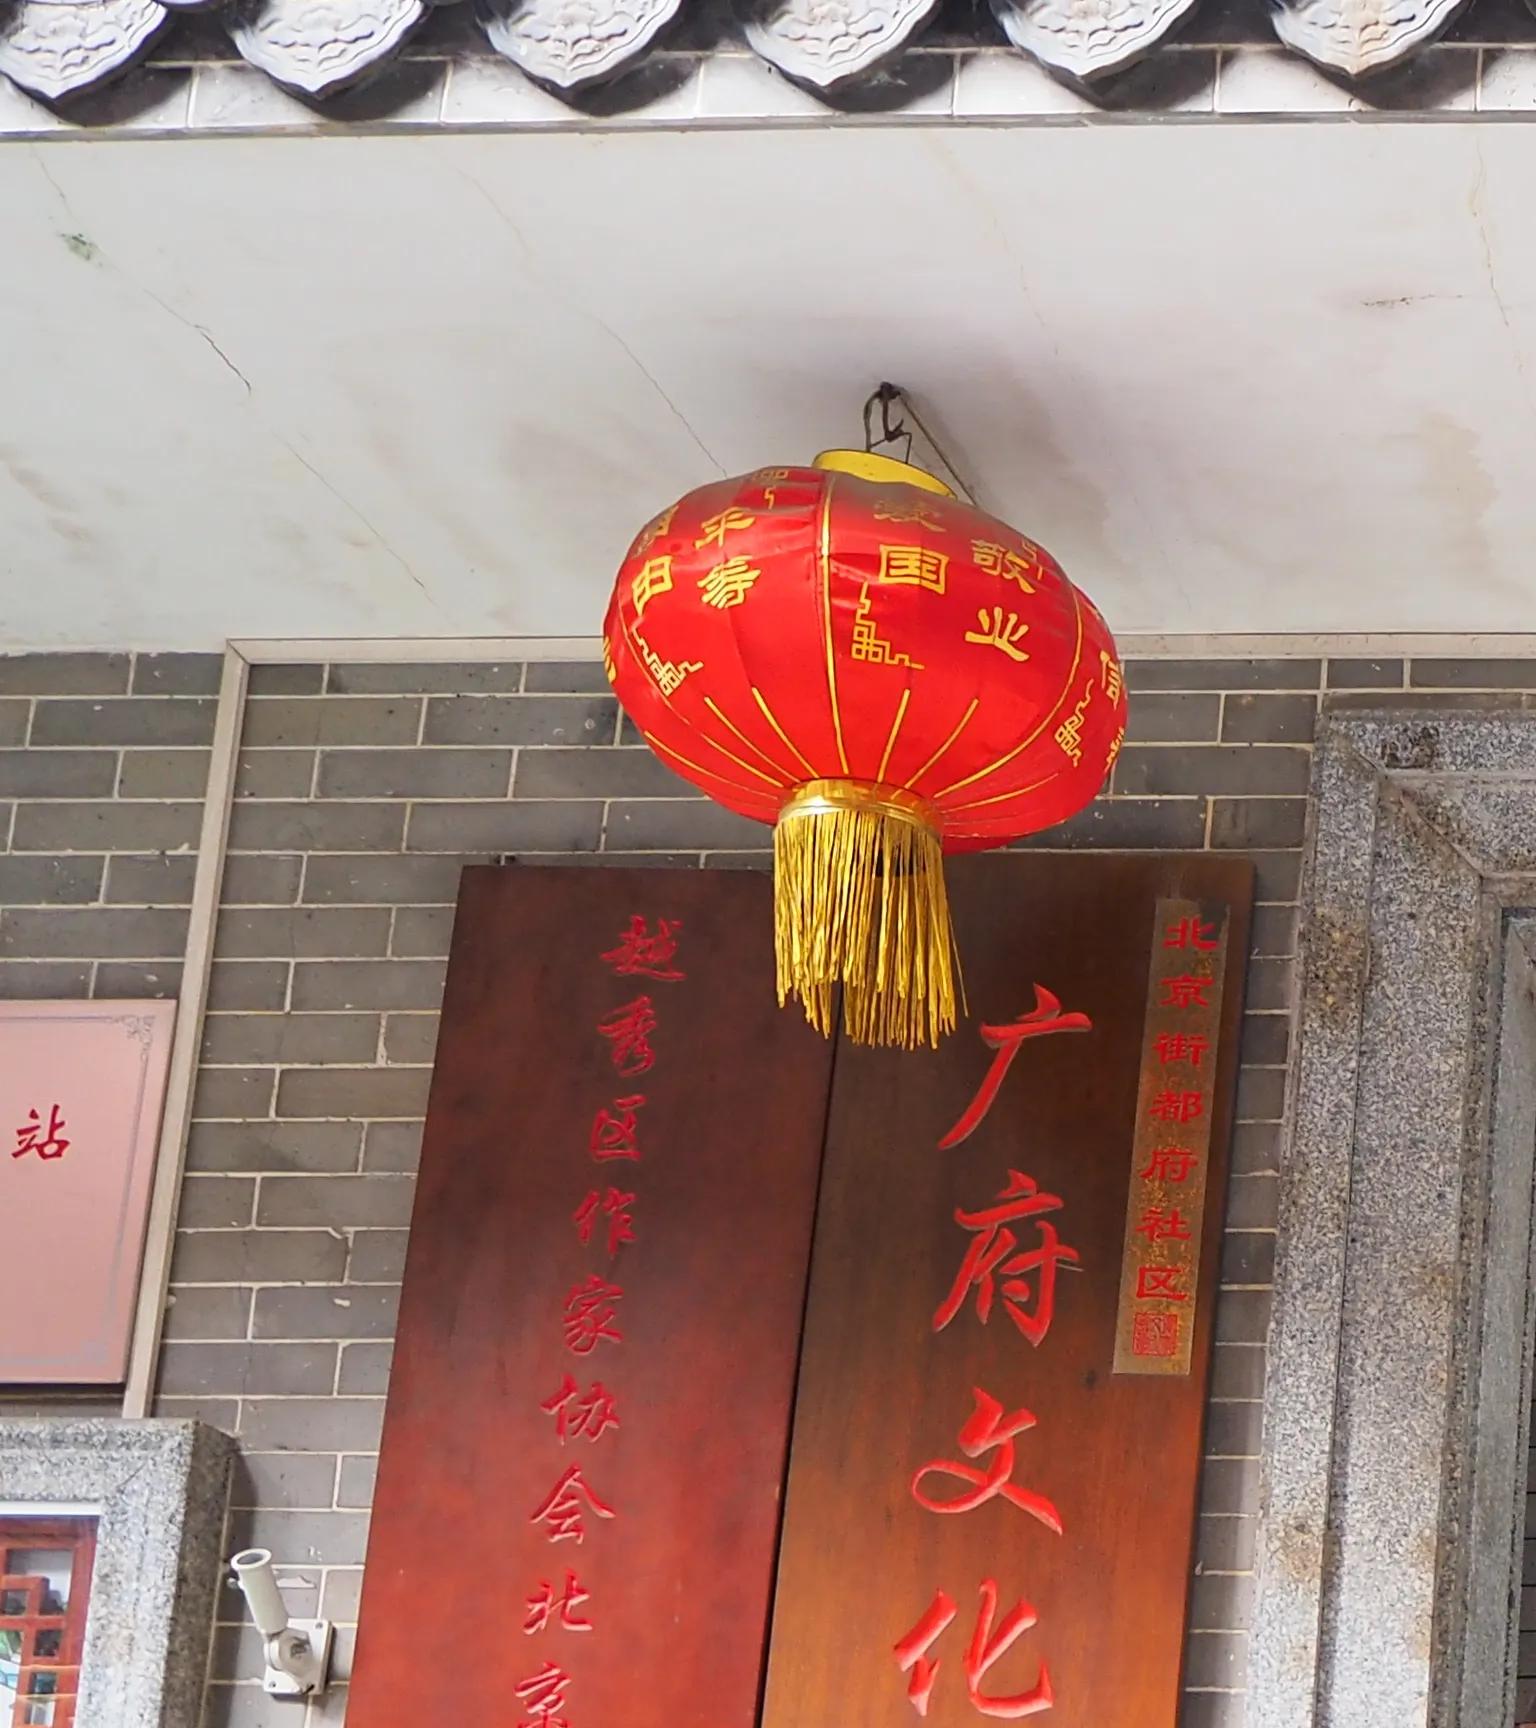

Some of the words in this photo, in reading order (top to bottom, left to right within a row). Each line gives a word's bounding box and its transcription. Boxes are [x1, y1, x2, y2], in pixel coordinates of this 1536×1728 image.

[694, 507, 761, 609] 平等
[965, 539, 1036, 662] 敬业
[11, 1103, 71, 1161] 站
[1135, 916, 1220, 1303] 北京街都府社区
